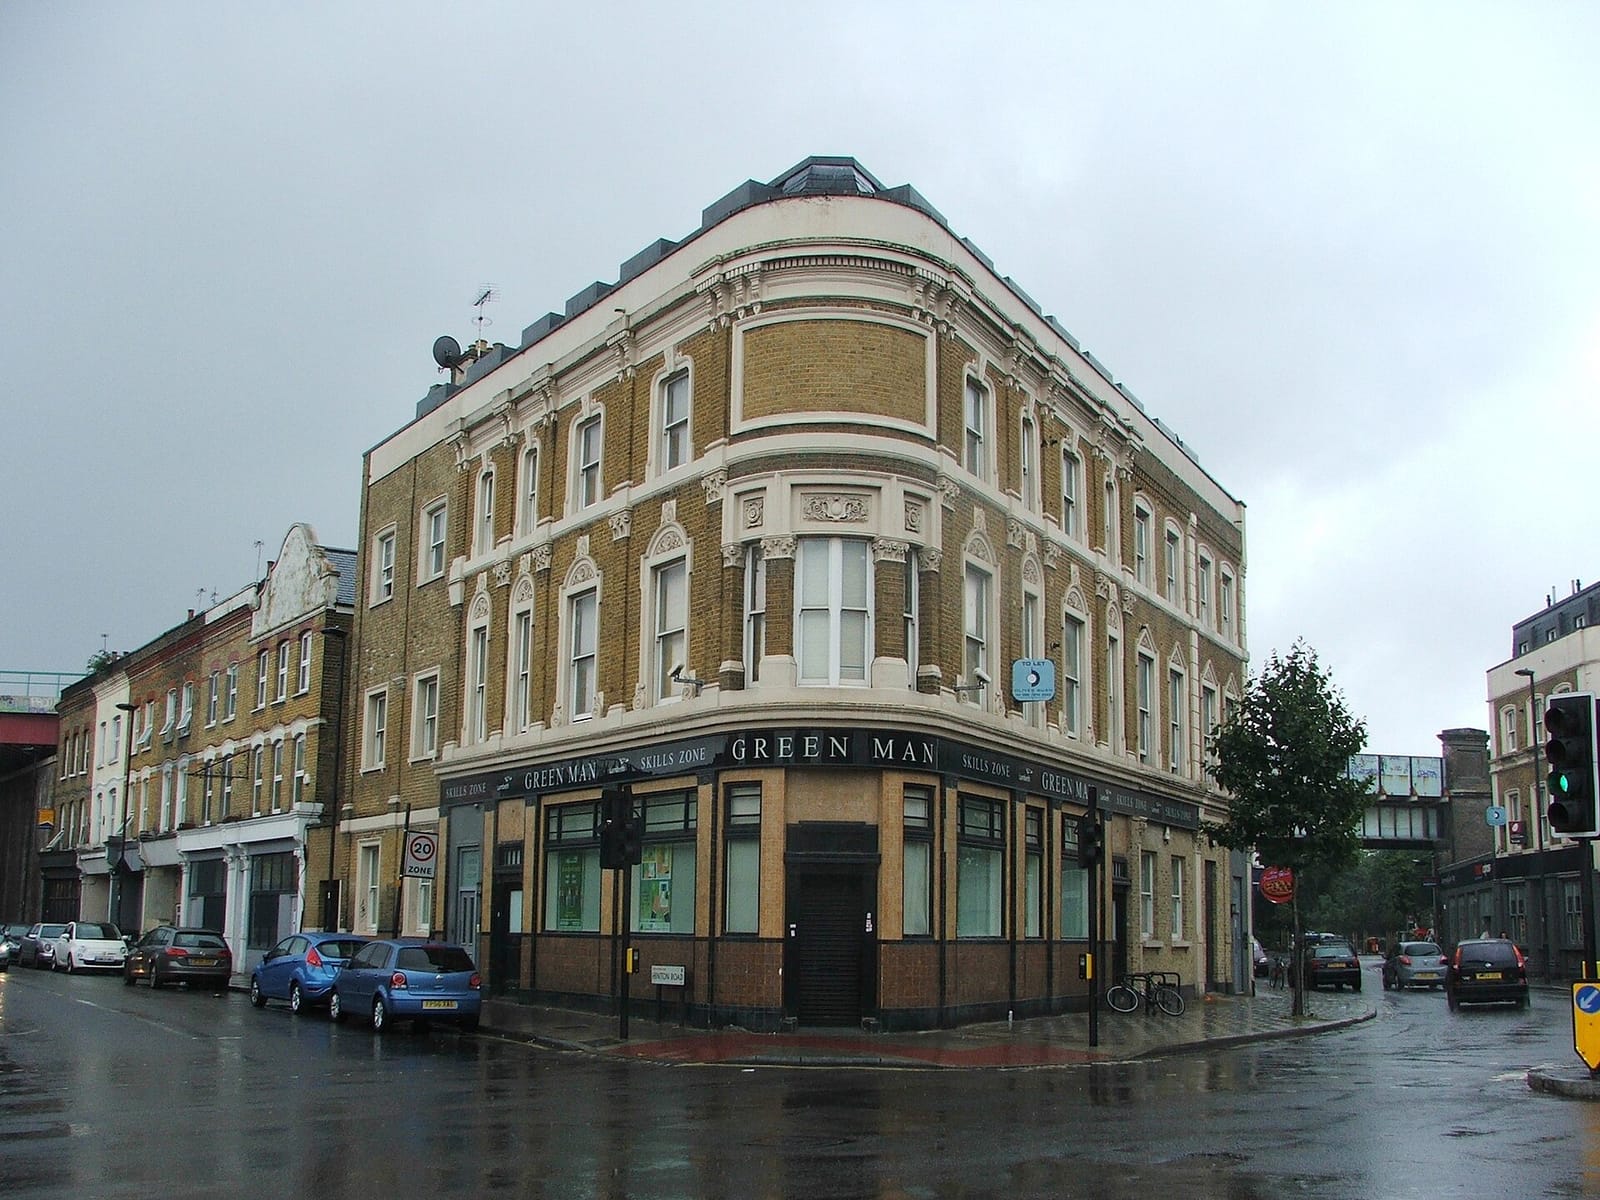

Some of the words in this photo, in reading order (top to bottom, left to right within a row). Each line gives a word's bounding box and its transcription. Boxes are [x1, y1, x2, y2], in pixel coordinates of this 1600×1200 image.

[640, 752, 675, 770] SKILLS
[679, 747, 707, 764] ZONE
[732, 736, 850, 761] GREEN
[872, 738, 935, 764] MAN
[524, 767, 565, 790] GREEN
[567, 761, 598, 783] MAN
[962, 754, 989, 773] SKILLS
[991, 761, 1011, 778] ZONE
[445, 784, 468, 799] SKILLS
[469, 782, 487, 795] ZONE
[1041, 771, 1073, 796] GREEN
[1075, 780, 1096, 800] MA
[414, 842, 432, 855] 20
[408, 865, 433, 875] ZONE
